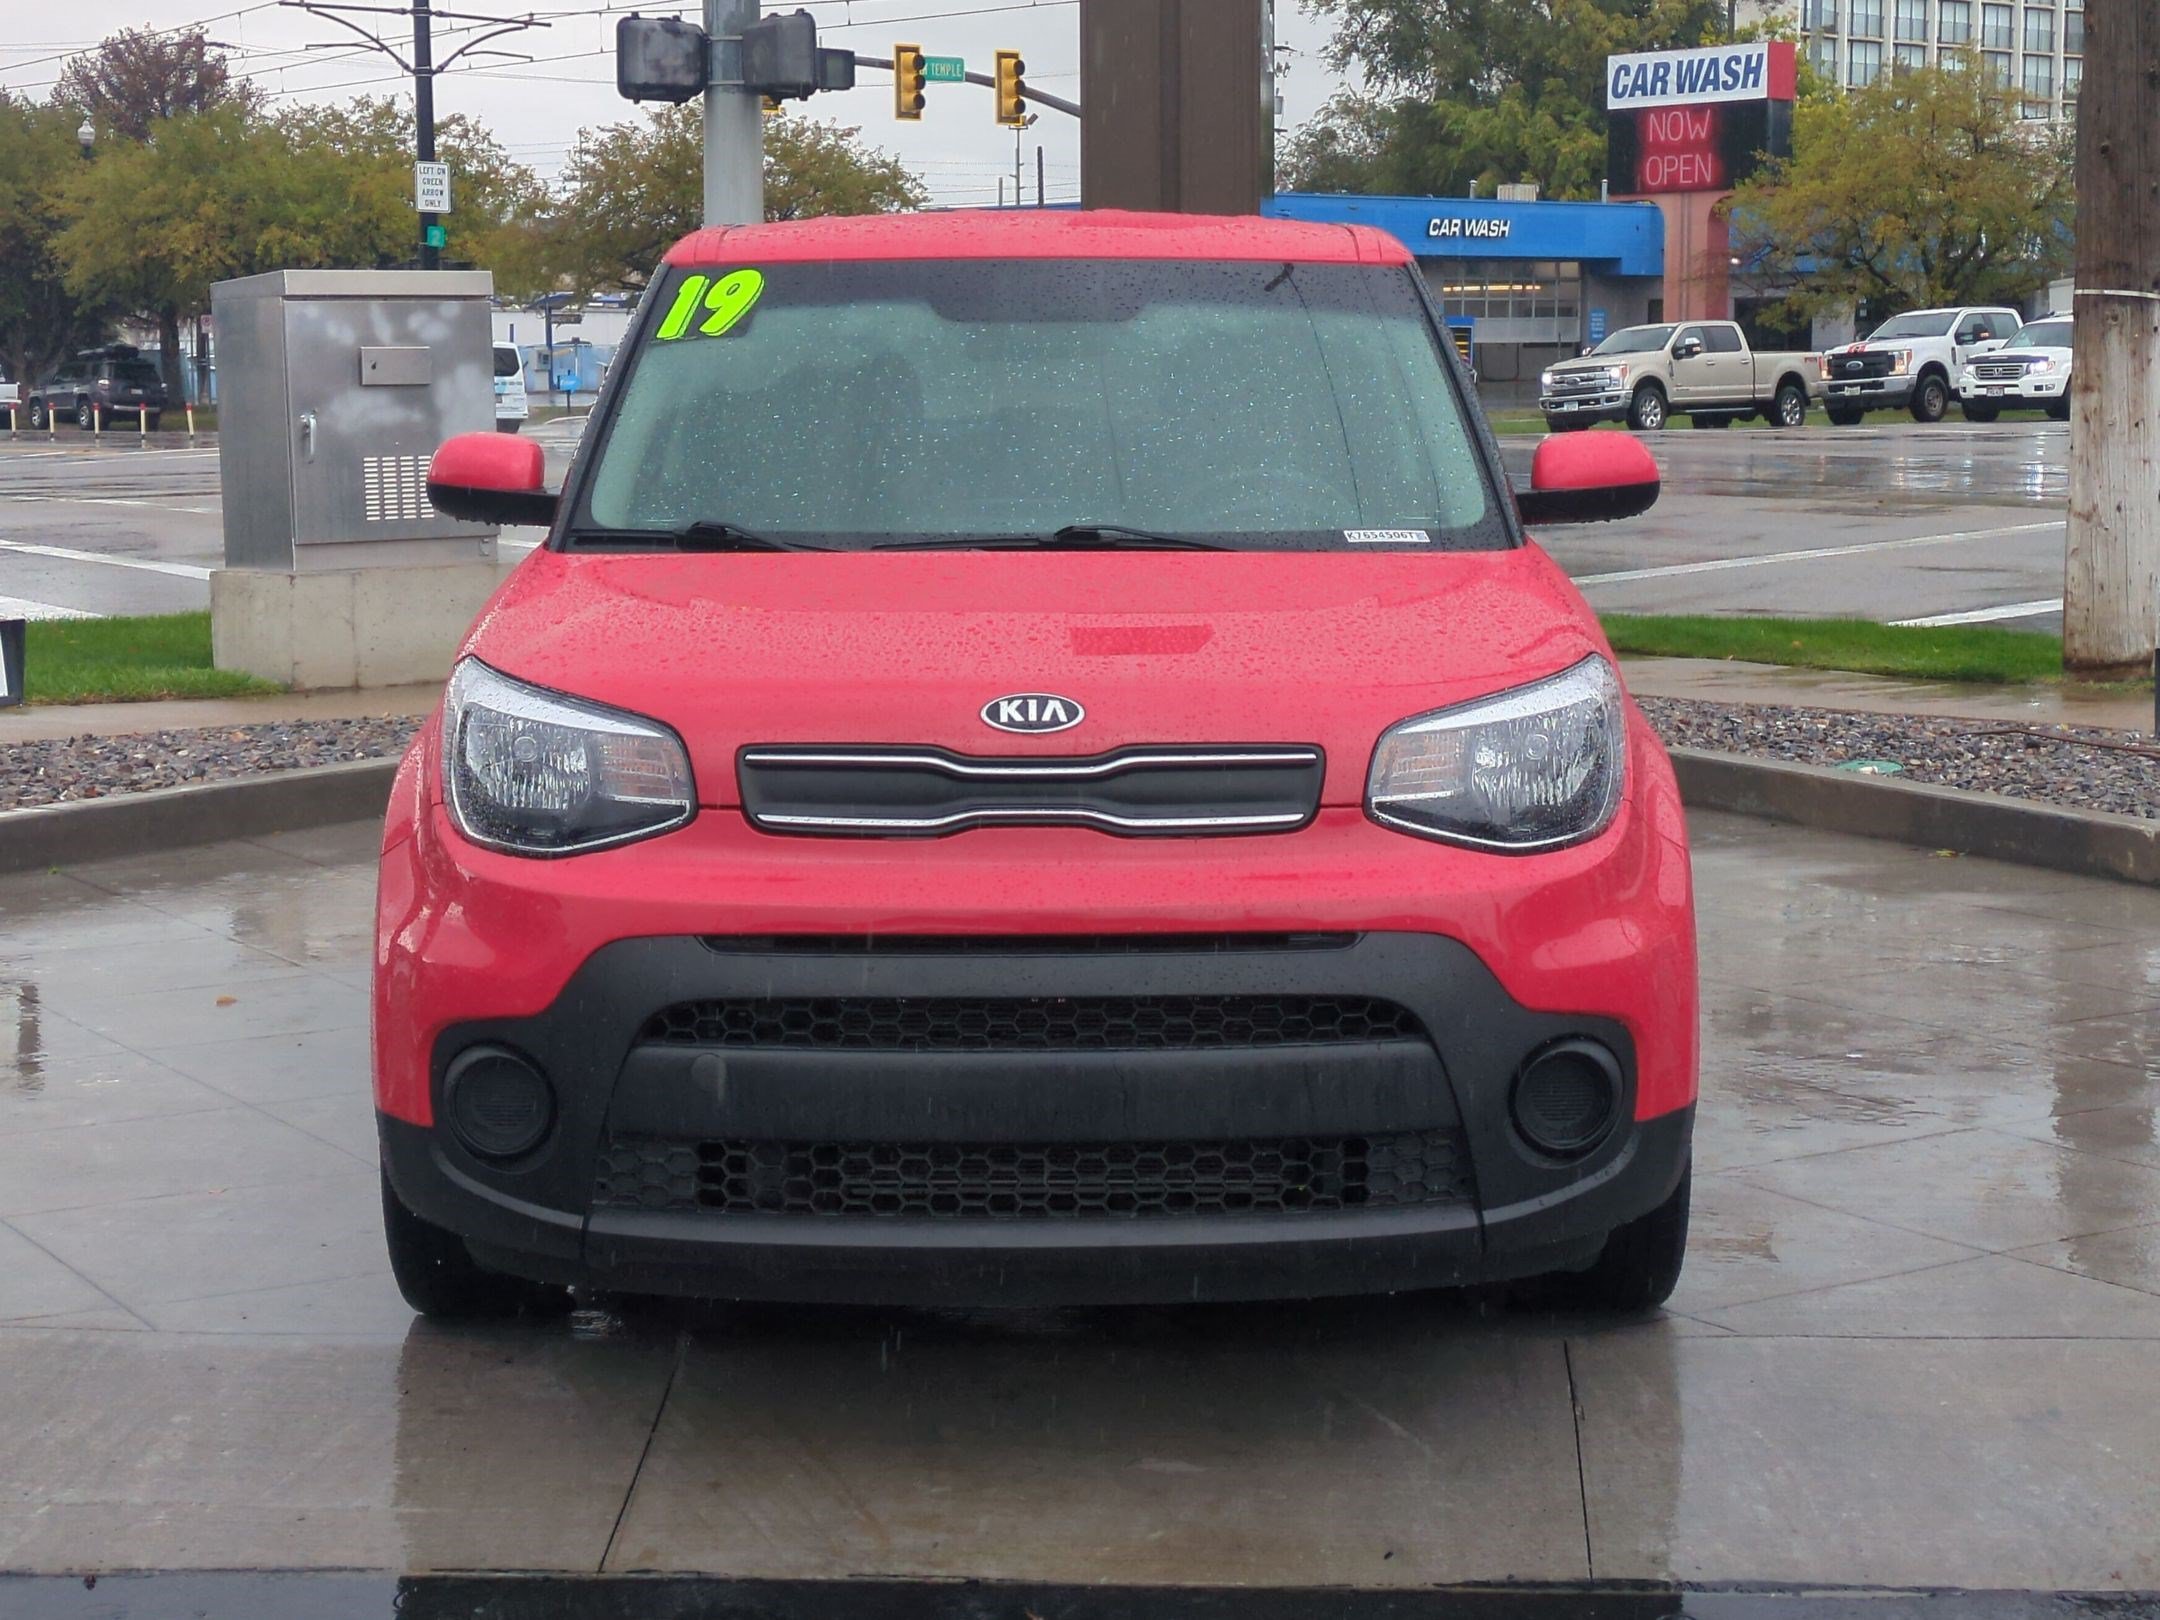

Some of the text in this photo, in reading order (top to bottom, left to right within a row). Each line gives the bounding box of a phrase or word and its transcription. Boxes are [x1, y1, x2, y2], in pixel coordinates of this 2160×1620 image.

[931, 62, 962, 77] TEMPLE
[1611, 53, 1764, 99] CAR WASH
[1649, 108, 1711, 143] NOW
[419, 166, 446, 175] LEFT ON
[1646, 152, 1712, 186] OPEN
[422, 177, 443, 186] GREEN
[424, 199, 441, 208] ONLY
[1428, 218, 1511, 237] CAR WASH
[656, 268, 765, 341] 19
[998, 699, 1068, 723] KIA
